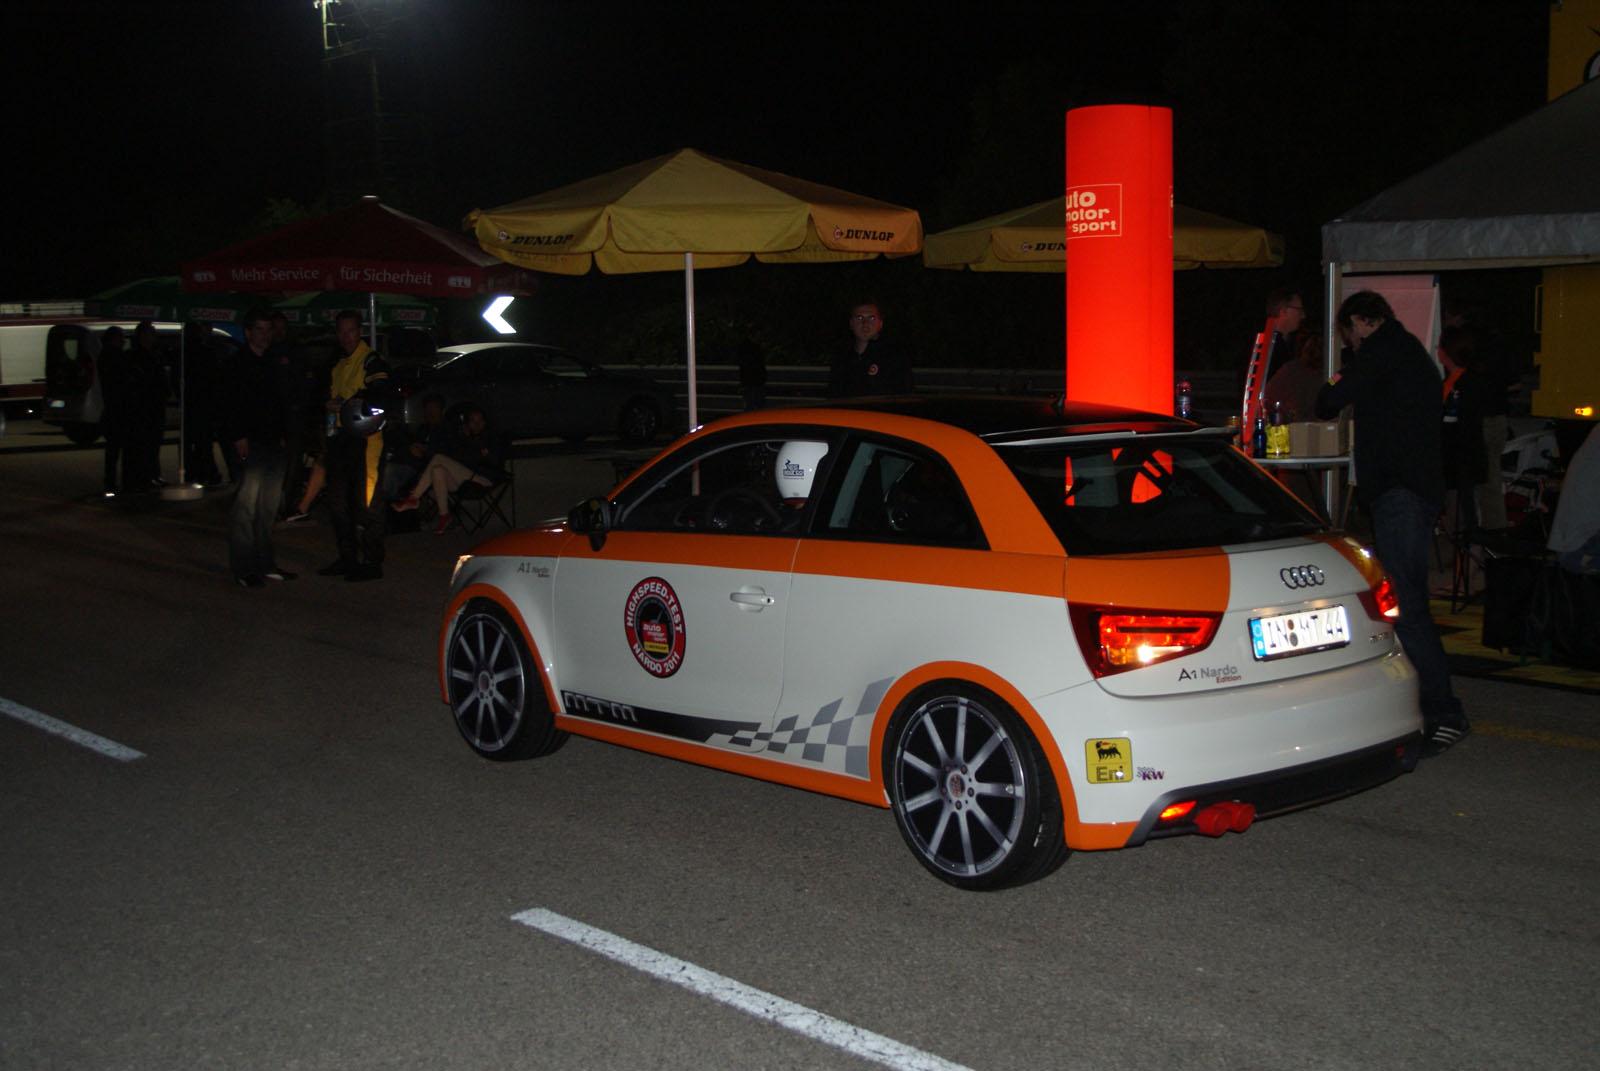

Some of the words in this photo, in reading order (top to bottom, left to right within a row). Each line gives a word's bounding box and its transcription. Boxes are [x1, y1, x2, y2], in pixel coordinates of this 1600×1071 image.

[1066, 191, 1096, 209] uto
[1072, 220, 1116, 233] sport
[511, 234, 574, 246] DUNLOP
[845, 229, 894, 241] DUNLOP
[1035, 242, 1067, 251] DUN
[231, 268, 268, 281] Mehr
[270, 267, 320, 281] Service
[340, 266, 361, 281] für
[363, 268, 432, 285] Sicherheit
[633, 642, 663, 673] NARDO
[1178, 667, 1197, 682] A1
[1200, 664, 1239, 679] Nardo
[1216, 675, 1242, 684] Edition
[1142, 770, 1165, 781] KW
